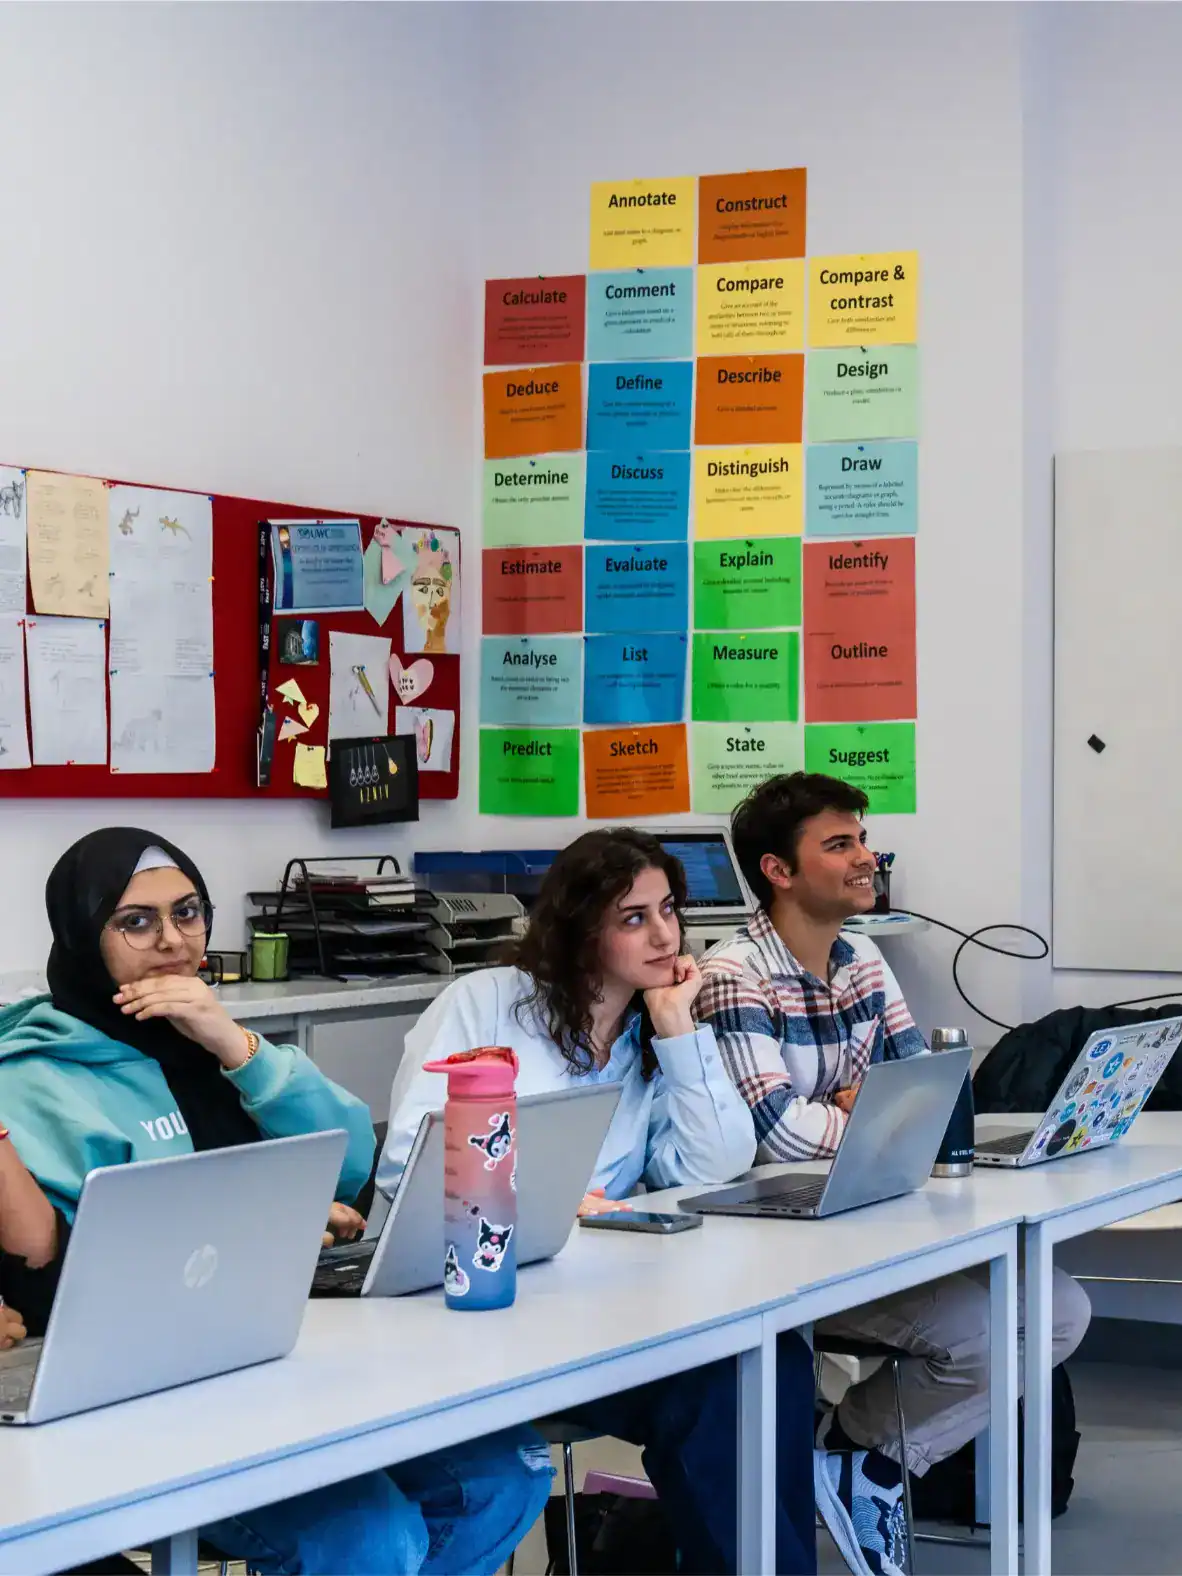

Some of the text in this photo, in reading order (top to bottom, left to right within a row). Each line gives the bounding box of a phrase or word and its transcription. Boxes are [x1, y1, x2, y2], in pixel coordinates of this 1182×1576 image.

[609, 192, 676, 208] Annotate
[716, 195, 787, 212] Construct
[820, 265, 904, 286] Compare &
[606, 283, 675, 299] Comment
[717, 278, 783, 293] Compare
[503, 290, 567, 305] Calculate
[831, 294, 893, 309] contrast
[718, 368, 781, 383] Describe
[838, 361, 888, 379] Design
[507, 380, 558, 397] Deduce
[616, 375, 662, 390] Define
[612, 465, 663, 479] Discuss
[708, 457, 788, 477] Distinguish
[842, 457, 881, 471] Draw
[495, 470, 568, 486] Determine
[502, 560, 561, 575] Estimate
[606, 557, 667, 572] Evaluate
[720, 551, 773, 570] Explain
[830, 552, 888, 570] Identify
[623, 647, 648, 661] List
[713, 646, 778, 660] Measure
[831, 643, 887, 659] Outline
[503, 651, 557, 669] Analyse
[504, 741, 552, 756] Predict
[610, 739, 658, 756] Sketch
[727, 738, 765, 751] State
[829, 749, 889, 766] Suggest
